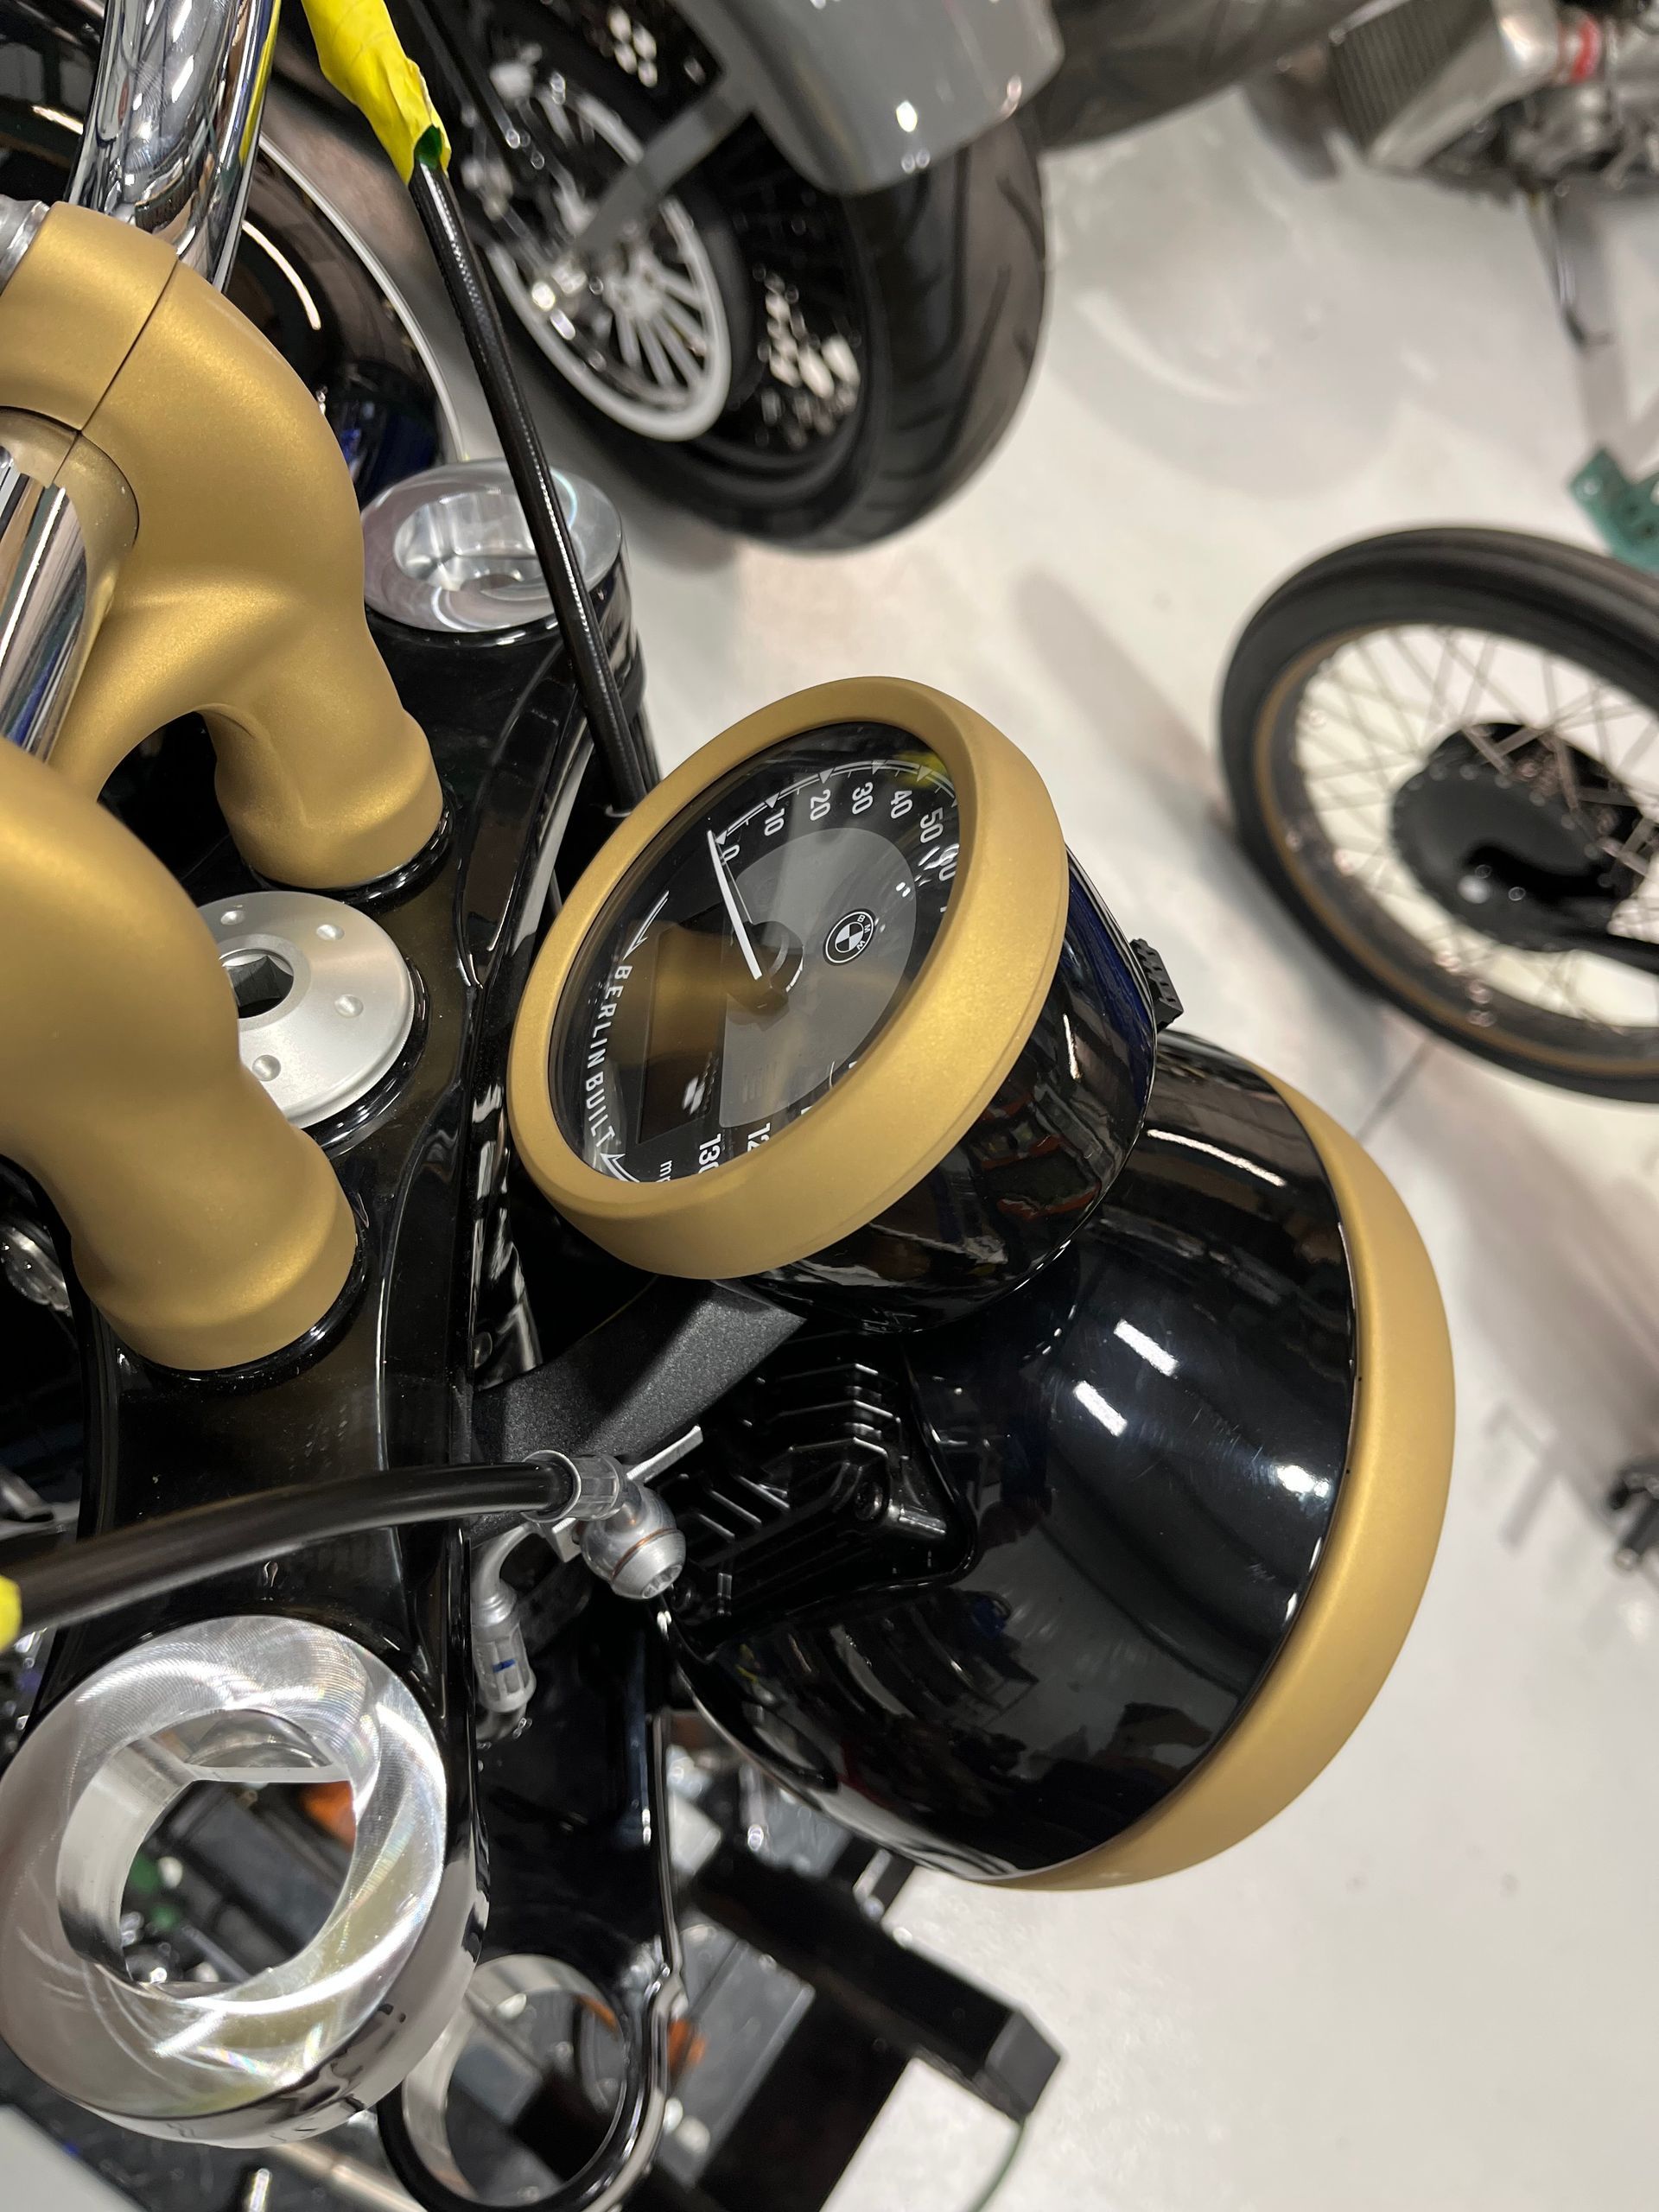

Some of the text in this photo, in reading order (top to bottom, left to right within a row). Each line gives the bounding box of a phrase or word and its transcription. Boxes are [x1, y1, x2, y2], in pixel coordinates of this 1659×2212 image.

[810, 789, 831, 821] 20
[851, 782, 874, 815] 30
[890, 790, 913, 819] 40
[764, 808, 785, 836] 10
[919, 807, 944, 843] 50
[720, 844, 741, 866] 0
[857, 914, 871, 950] BMW
